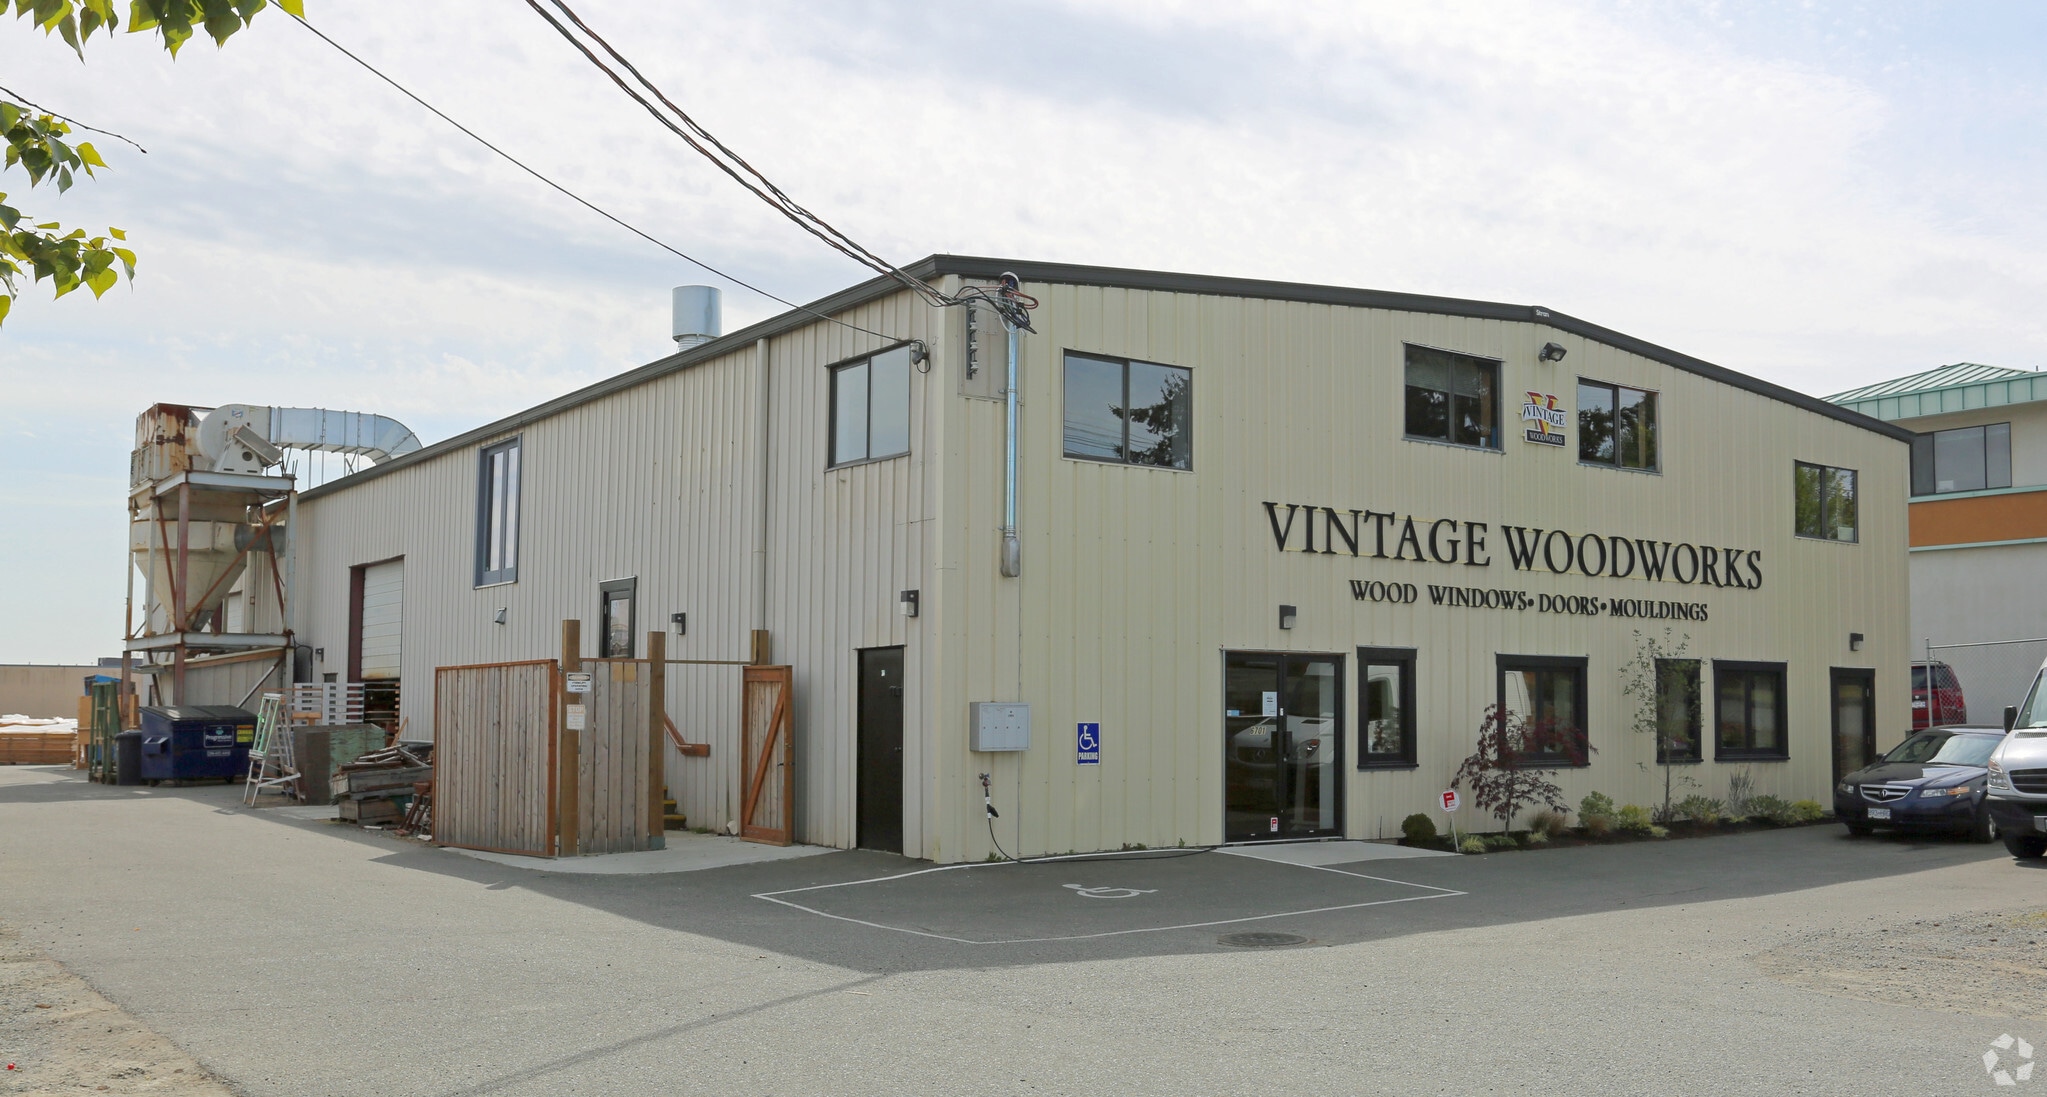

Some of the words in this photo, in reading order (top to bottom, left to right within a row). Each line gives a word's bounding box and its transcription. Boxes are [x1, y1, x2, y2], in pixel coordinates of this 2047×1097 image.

[1523, 405, 1565, 426] VINTAGE
[1530, 432, 1563, 444] WOODWORKS
[1262, 501, 1491, 567] VINTAGE
[1501, 524, 1763, 591] WOODWORKS
[1349, 580, 1418, 604] WOOD
[1538, 593, 1599, 616] DOORS
[1609, 598, 1709, 622] MOULDINGS
[1078, 752, 1098, 760] PARKING
